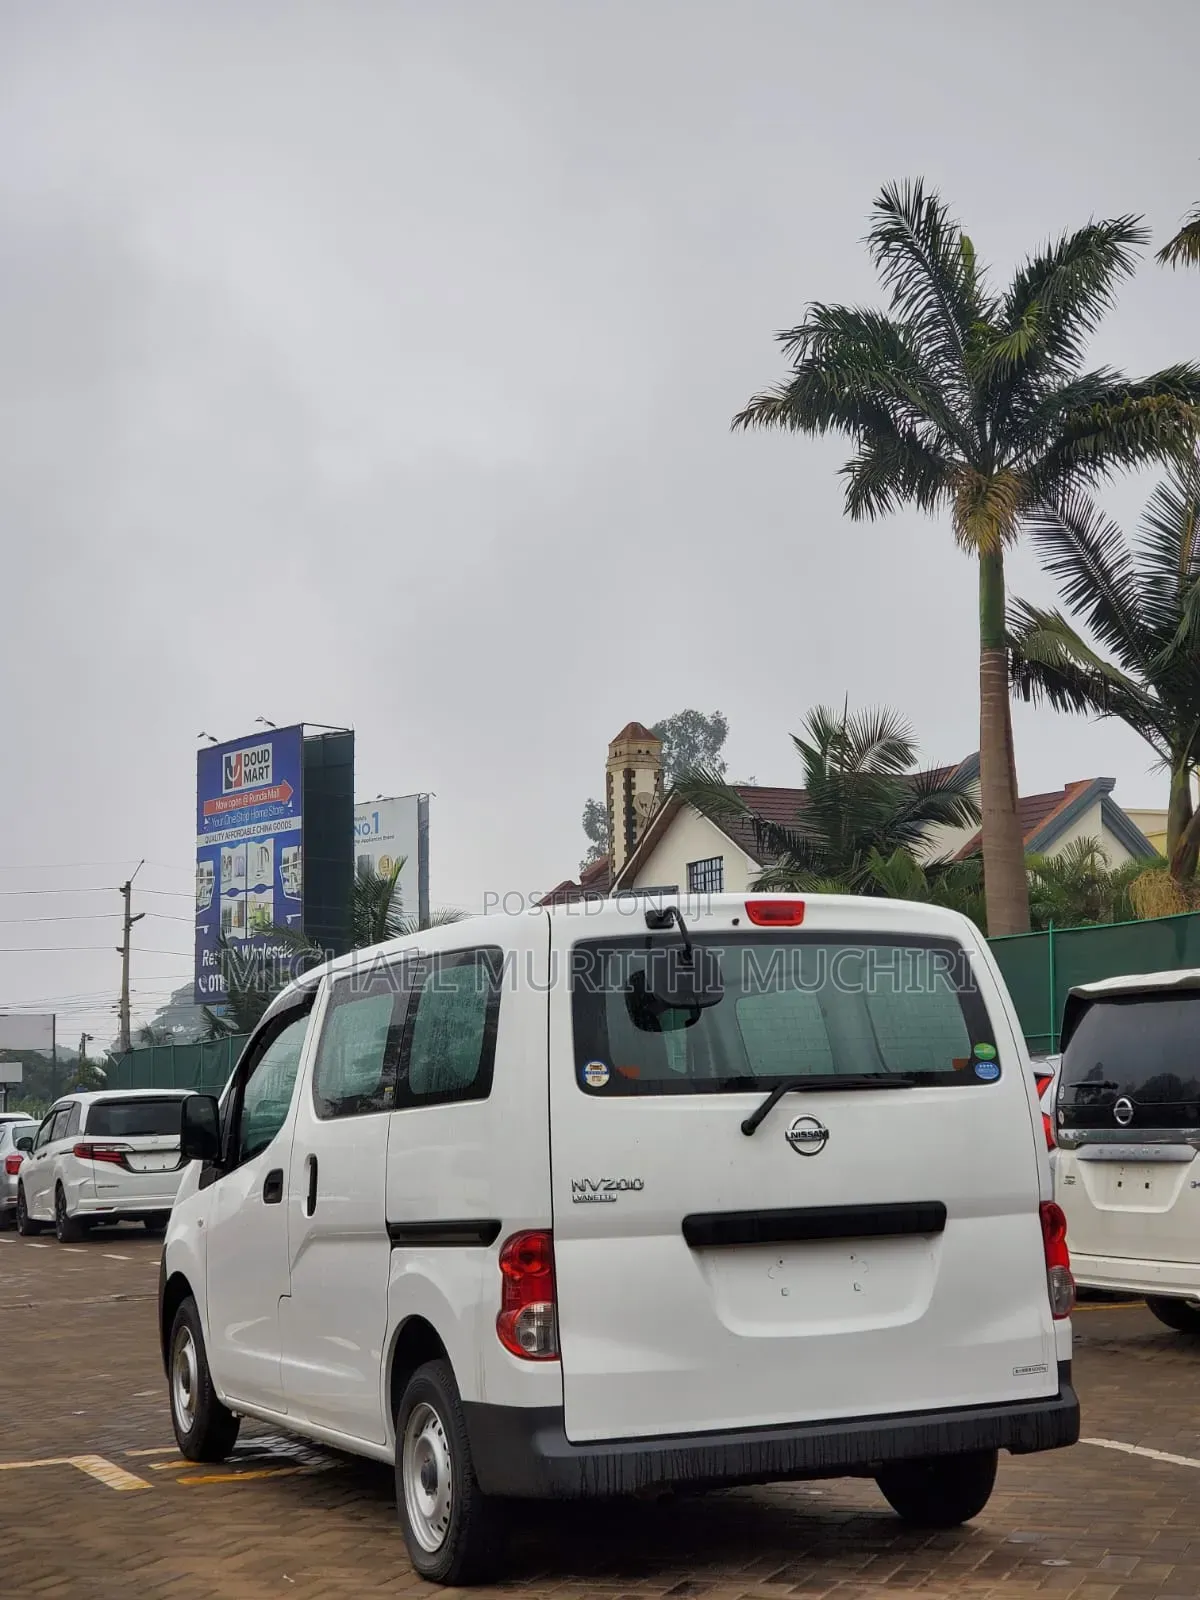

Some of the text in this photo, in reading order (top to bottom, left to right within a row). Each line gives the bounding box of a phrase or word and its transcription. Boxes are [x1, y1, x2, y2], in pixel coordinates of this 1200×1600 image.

[243, 748, 270, 768] DOUD
[243, 766, 270, 783] MART
[216, 800, 228, 811] Now
[228, 798, 241, 809] open
[267, 788, 280, 799] Mall
[211, 805, 284, 827] Your One Stop Home Store
[204, 820, 292, 844] QUALITY AFFORDABLE CHINA GOODS
[790, 1129, 826, 1139] NISSAN
[571, 1178, 645, 1193] NV200
